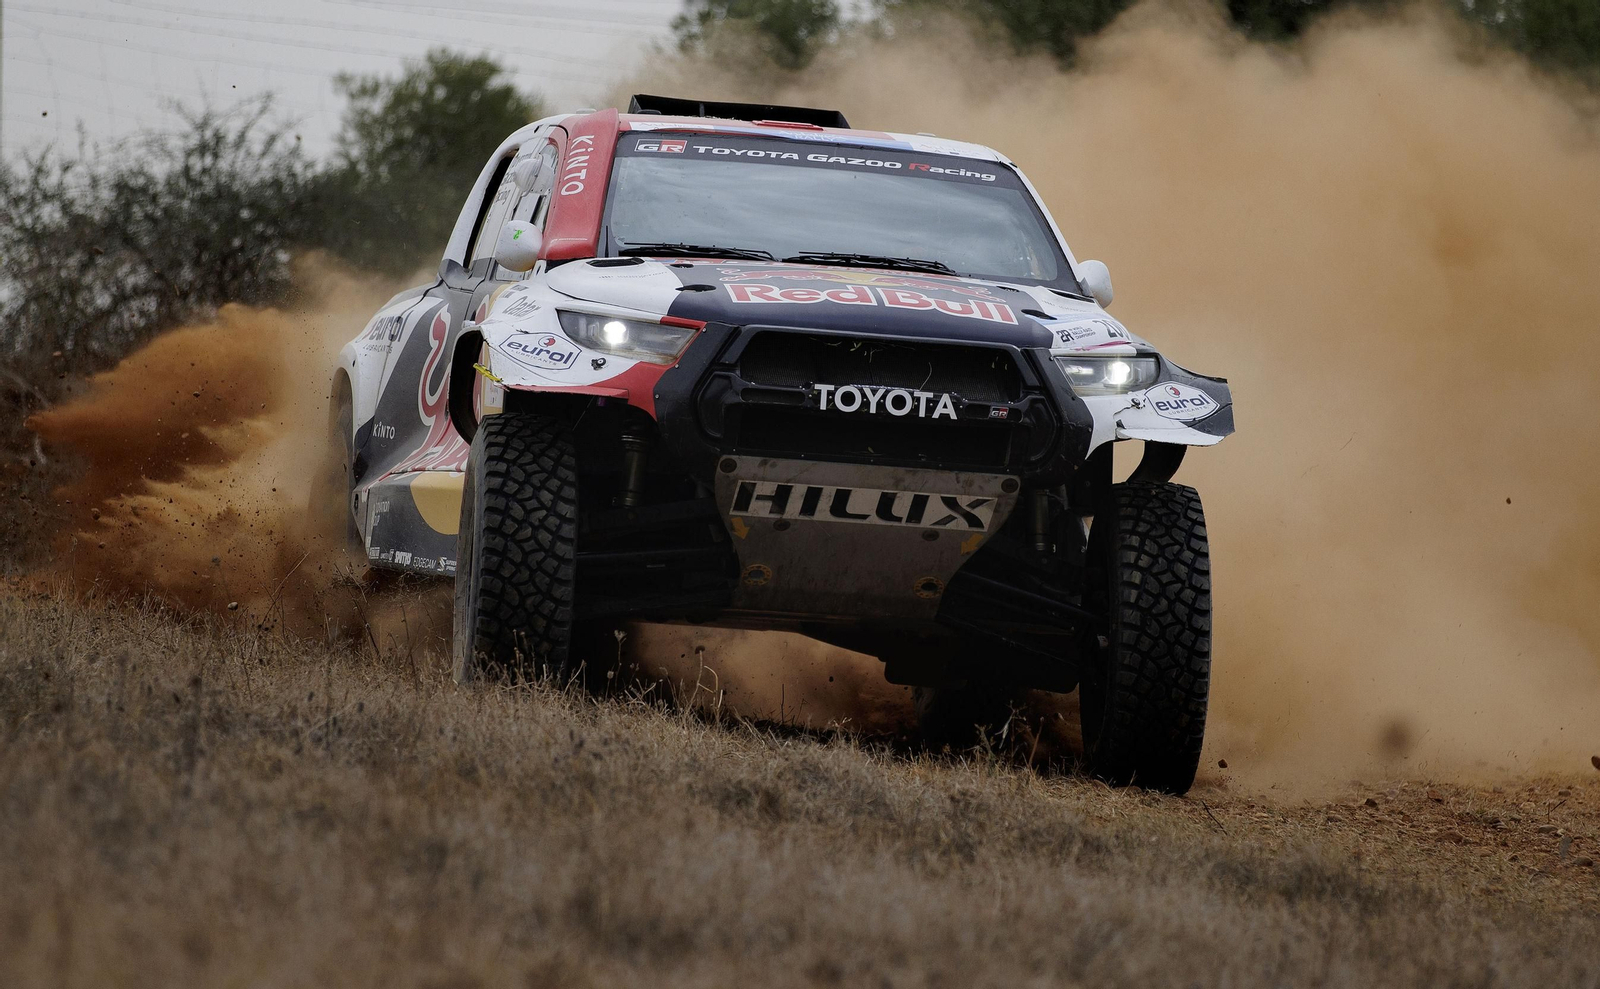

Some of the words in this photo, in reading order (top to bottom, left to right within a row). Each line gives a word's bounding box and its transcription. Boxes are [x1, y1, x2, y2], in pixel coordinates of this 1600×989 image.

[637, 142, 684, 152] GR
[693, 145, 800, 160] TOYOTA
[807, 153, 902, 169] GAZOO
[909, 163, 996, 182] Racing
[723, 284, 878, 306] Red
[877, 287, 1019, 325] Bull
[507, 341, 574, 365] eurol
[511, 350, 557, 366] LUBRICANTS
[814, 383, 958, 420] TOYOTA
[1155, 394, 1210, 411] eurol
[1169, 405, 1209, 415] LUBRICANTS
[990, 410, 1008, 419] GR
[732, 481, 995, 529] HILUX
[413, 556, 437, 569] EDGECAM
